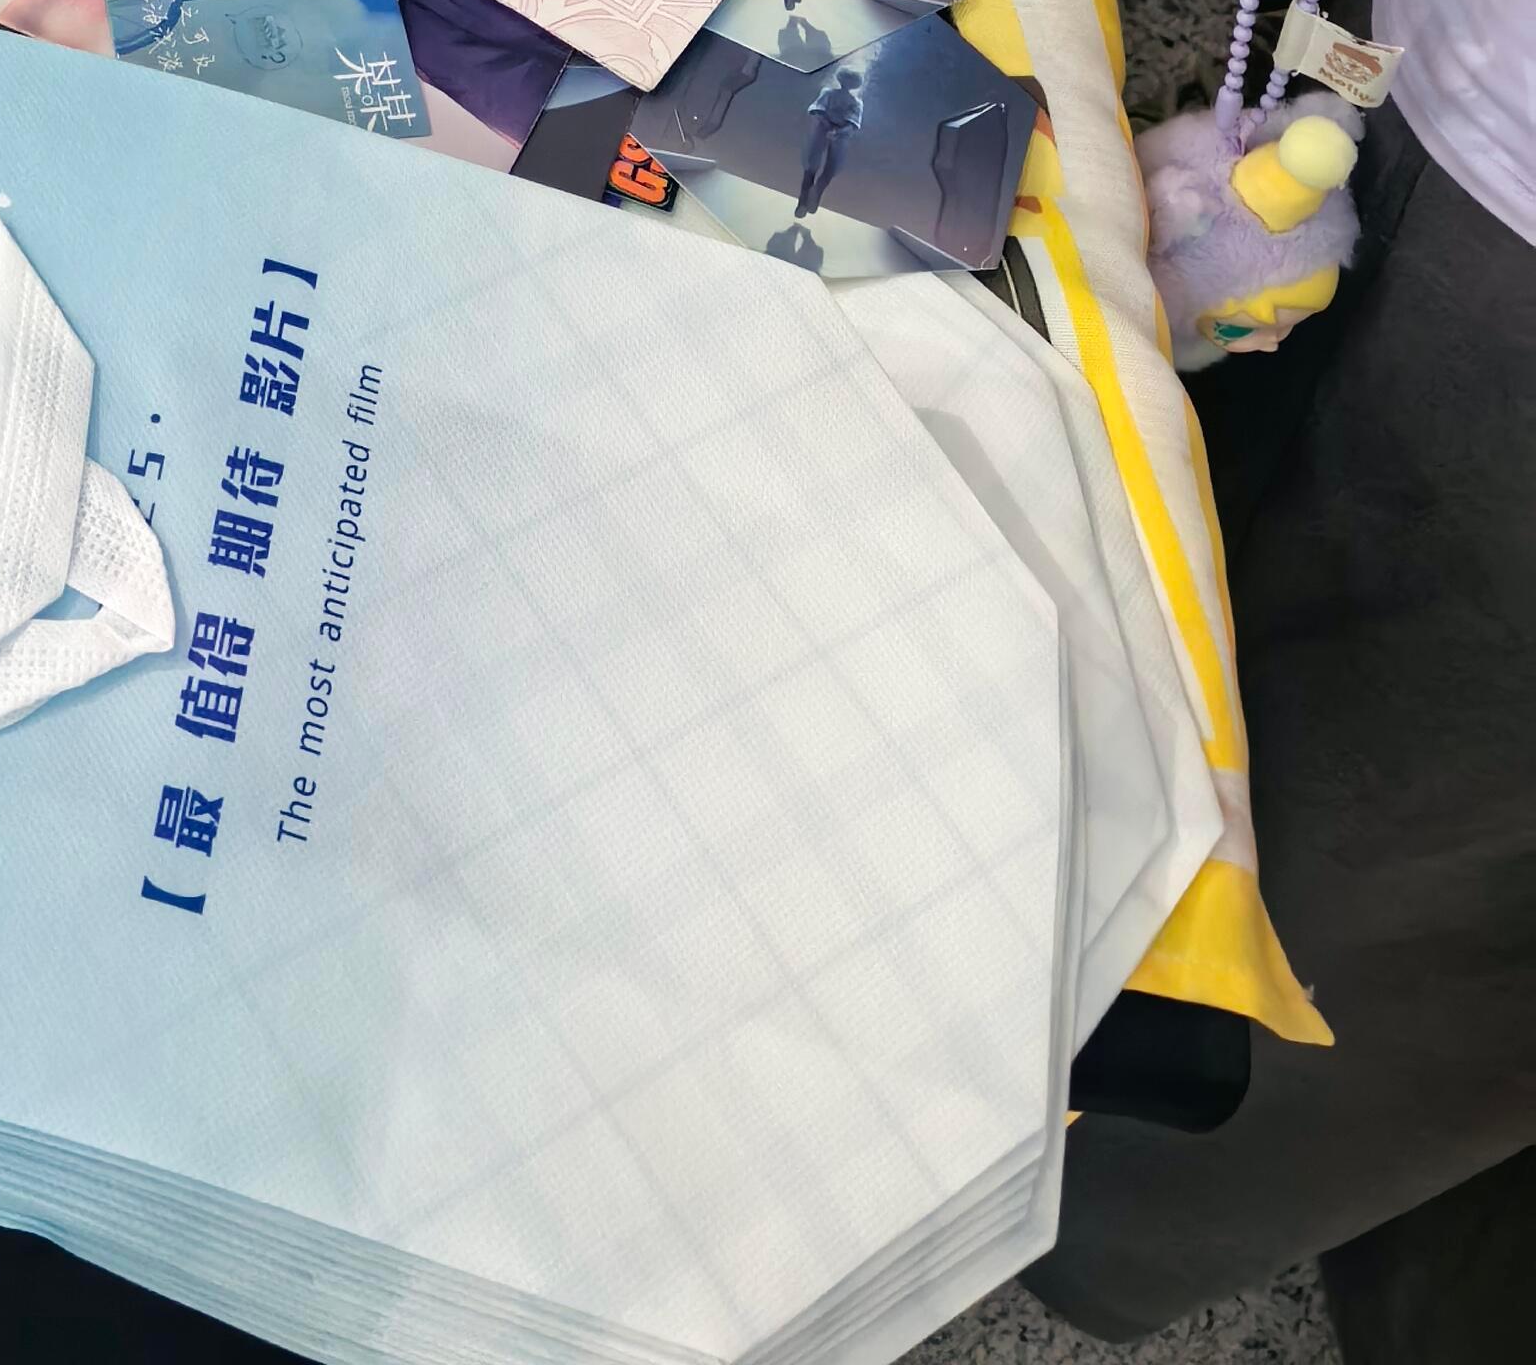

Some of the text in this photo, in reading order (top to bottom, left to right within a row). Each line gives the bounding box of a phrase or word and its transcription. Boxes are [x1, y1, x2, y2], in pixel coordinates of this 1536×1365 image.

[276, 362, 383, 846] The most anticipated film
